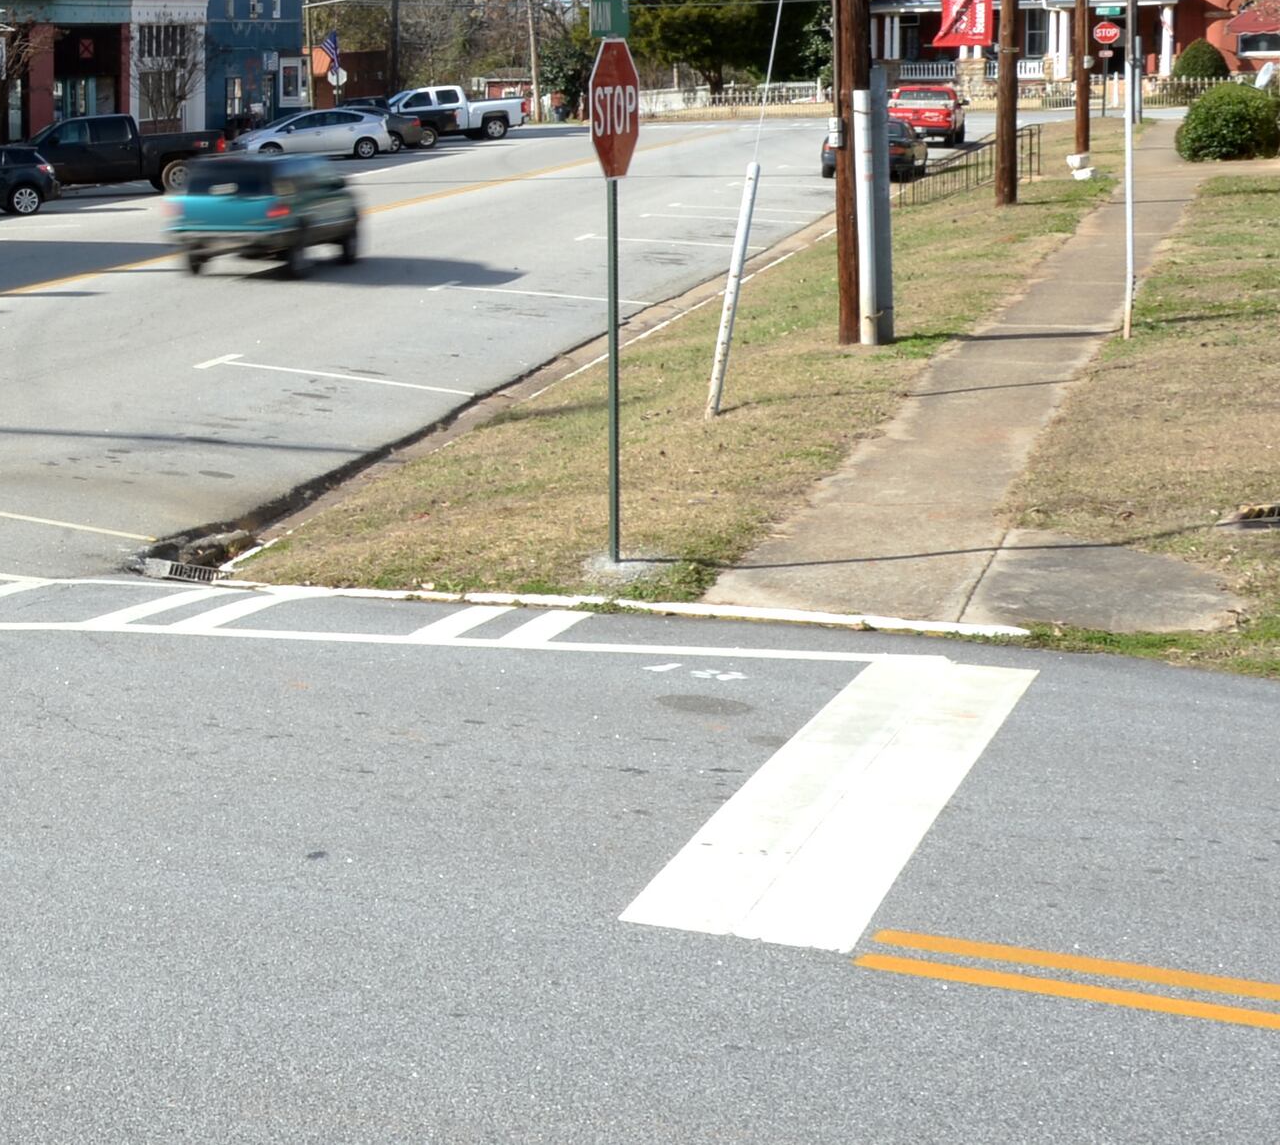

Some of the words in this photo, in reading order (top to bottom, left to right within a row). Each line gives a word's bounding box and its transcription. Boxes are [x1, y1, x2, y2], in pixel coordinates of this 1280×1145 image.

[591, 1, 612, 32] MAIN
[1096, 28, 1119, 37] STOP
[594, 85, 636, 138] STOP
